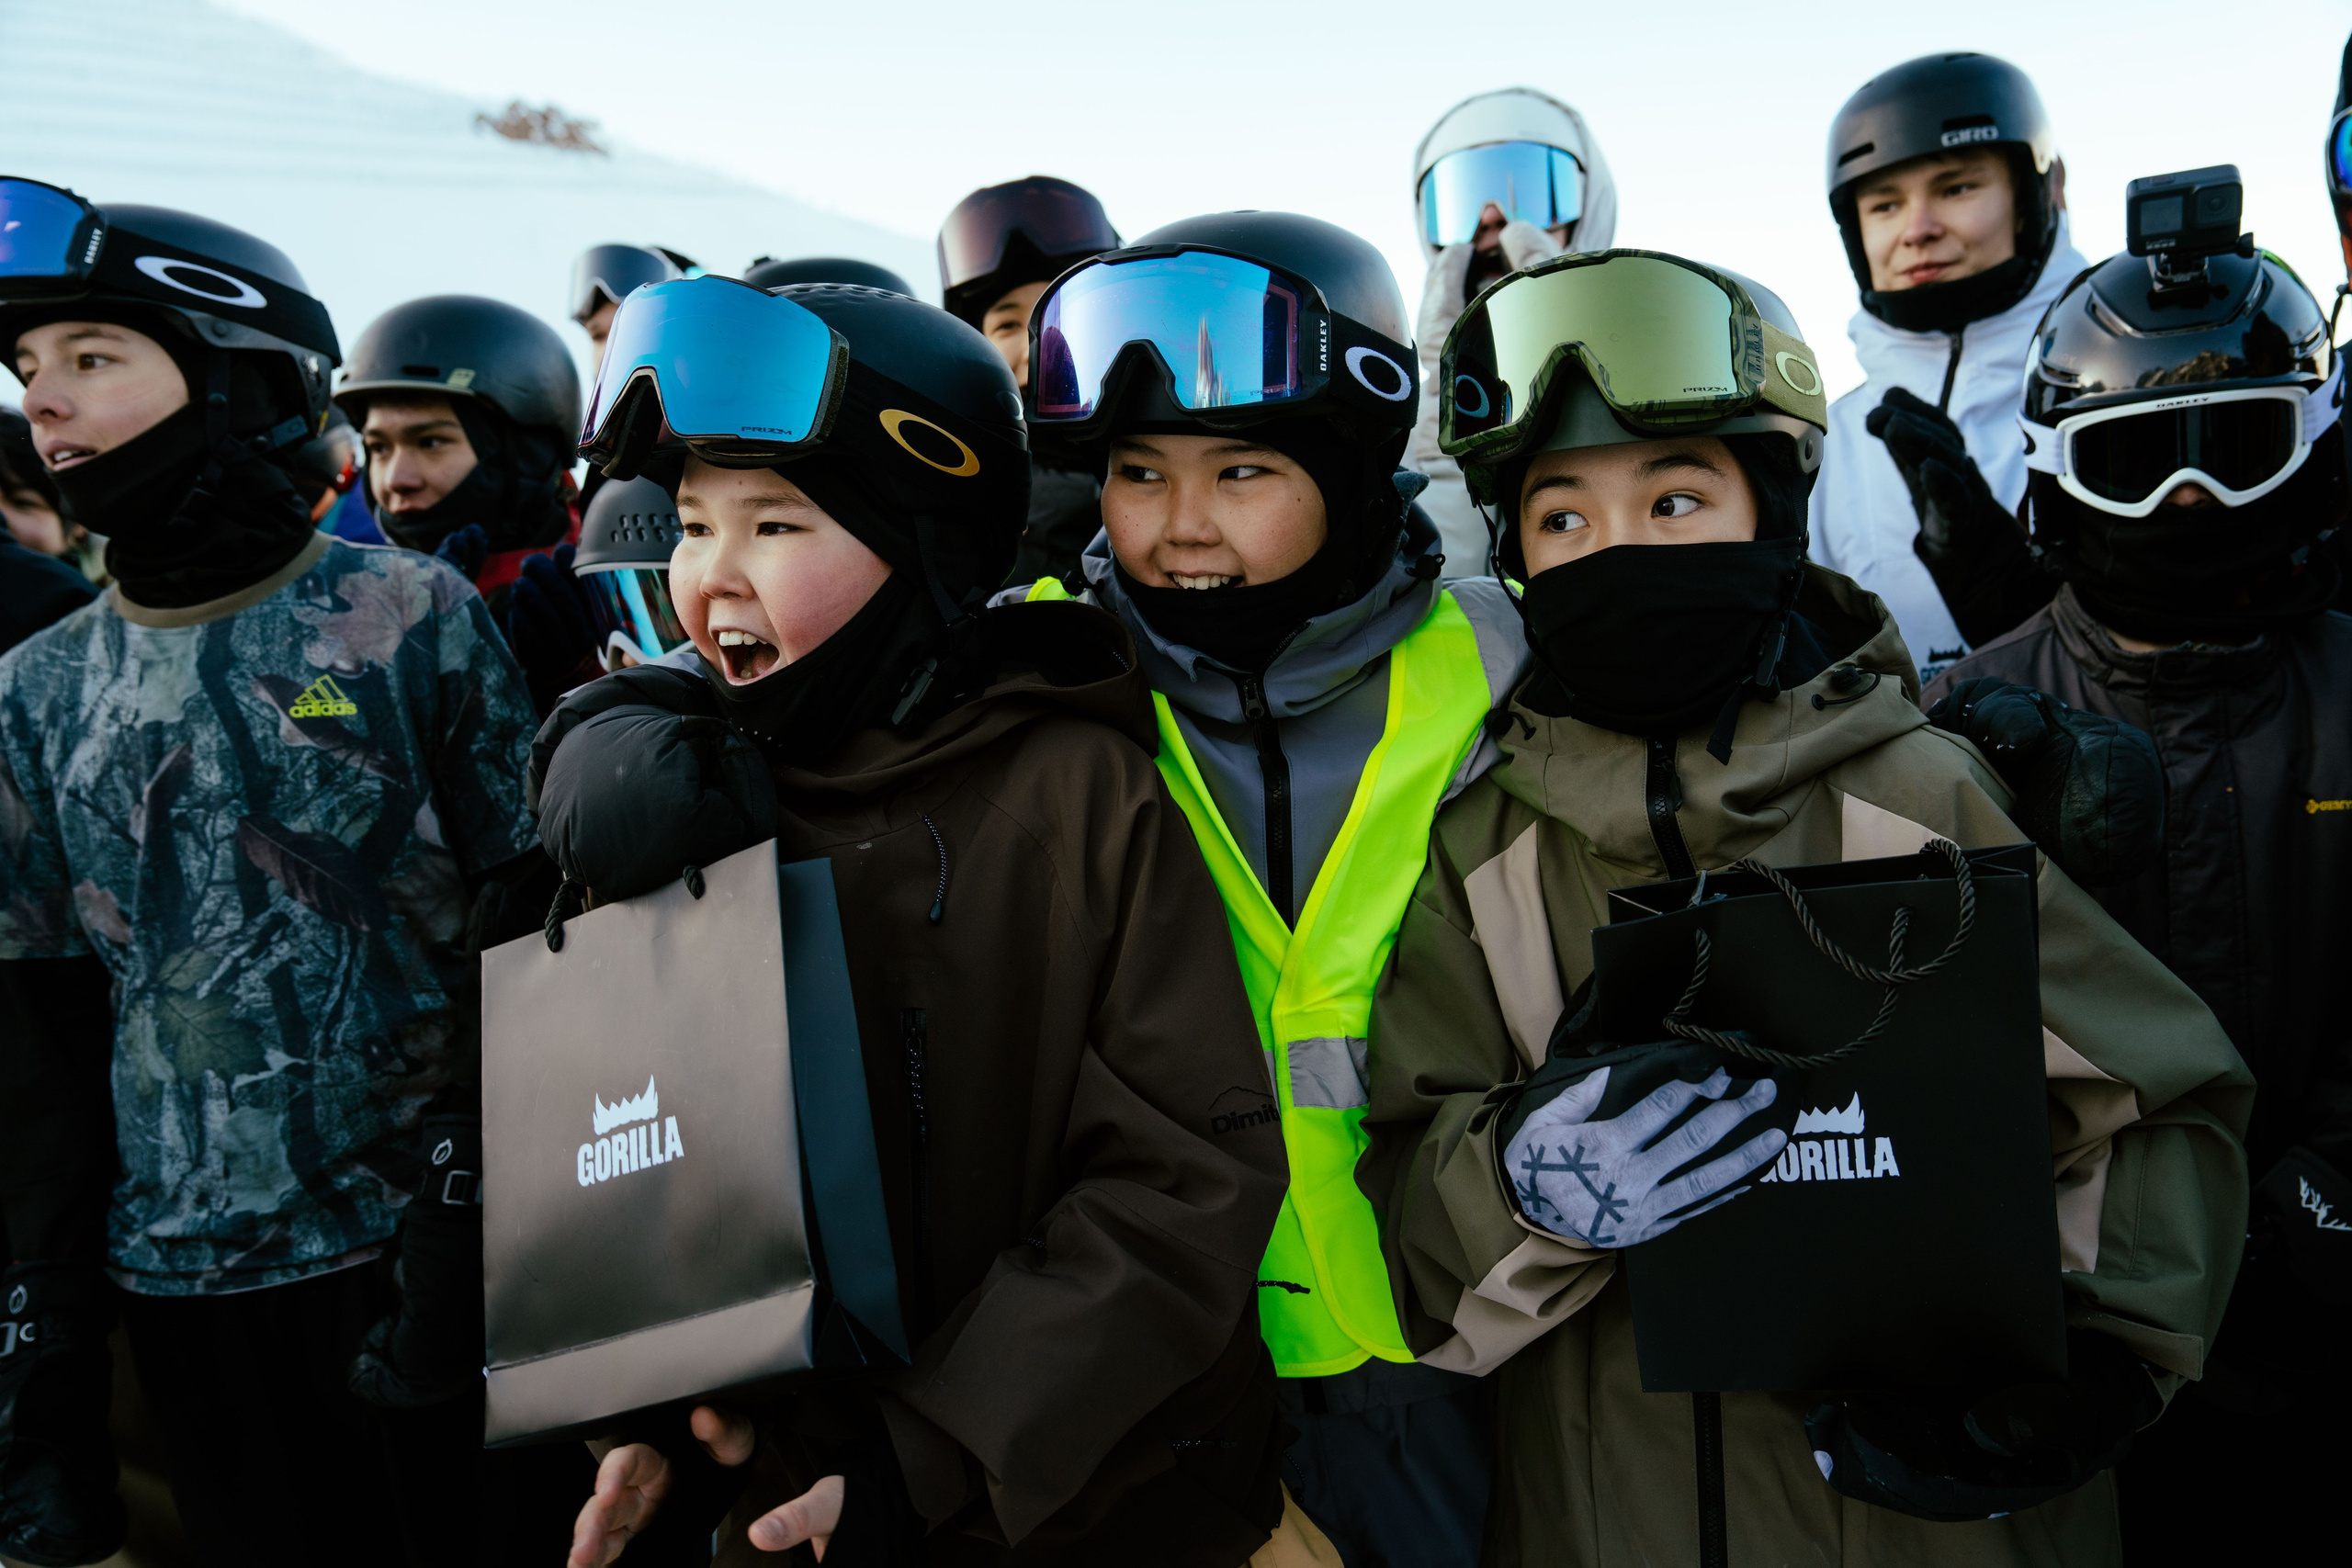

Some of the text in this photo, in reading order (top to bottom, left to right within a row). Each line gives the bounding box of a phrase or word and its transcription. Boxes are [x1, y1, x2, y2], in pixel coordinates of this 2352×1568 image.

[1940, 126, 1998, 147] GIRO
[84, 227, 103, 265] OAKLEY
[741, 426, 792, 435] PRIZM
[288, 702, 357, 718] adidas
[1210, 1103, 1281, 1134] Dimit
[577, 1114, 684, 1187] GORILLA
[1759, 1136, 1900, 1183] ORILLA
